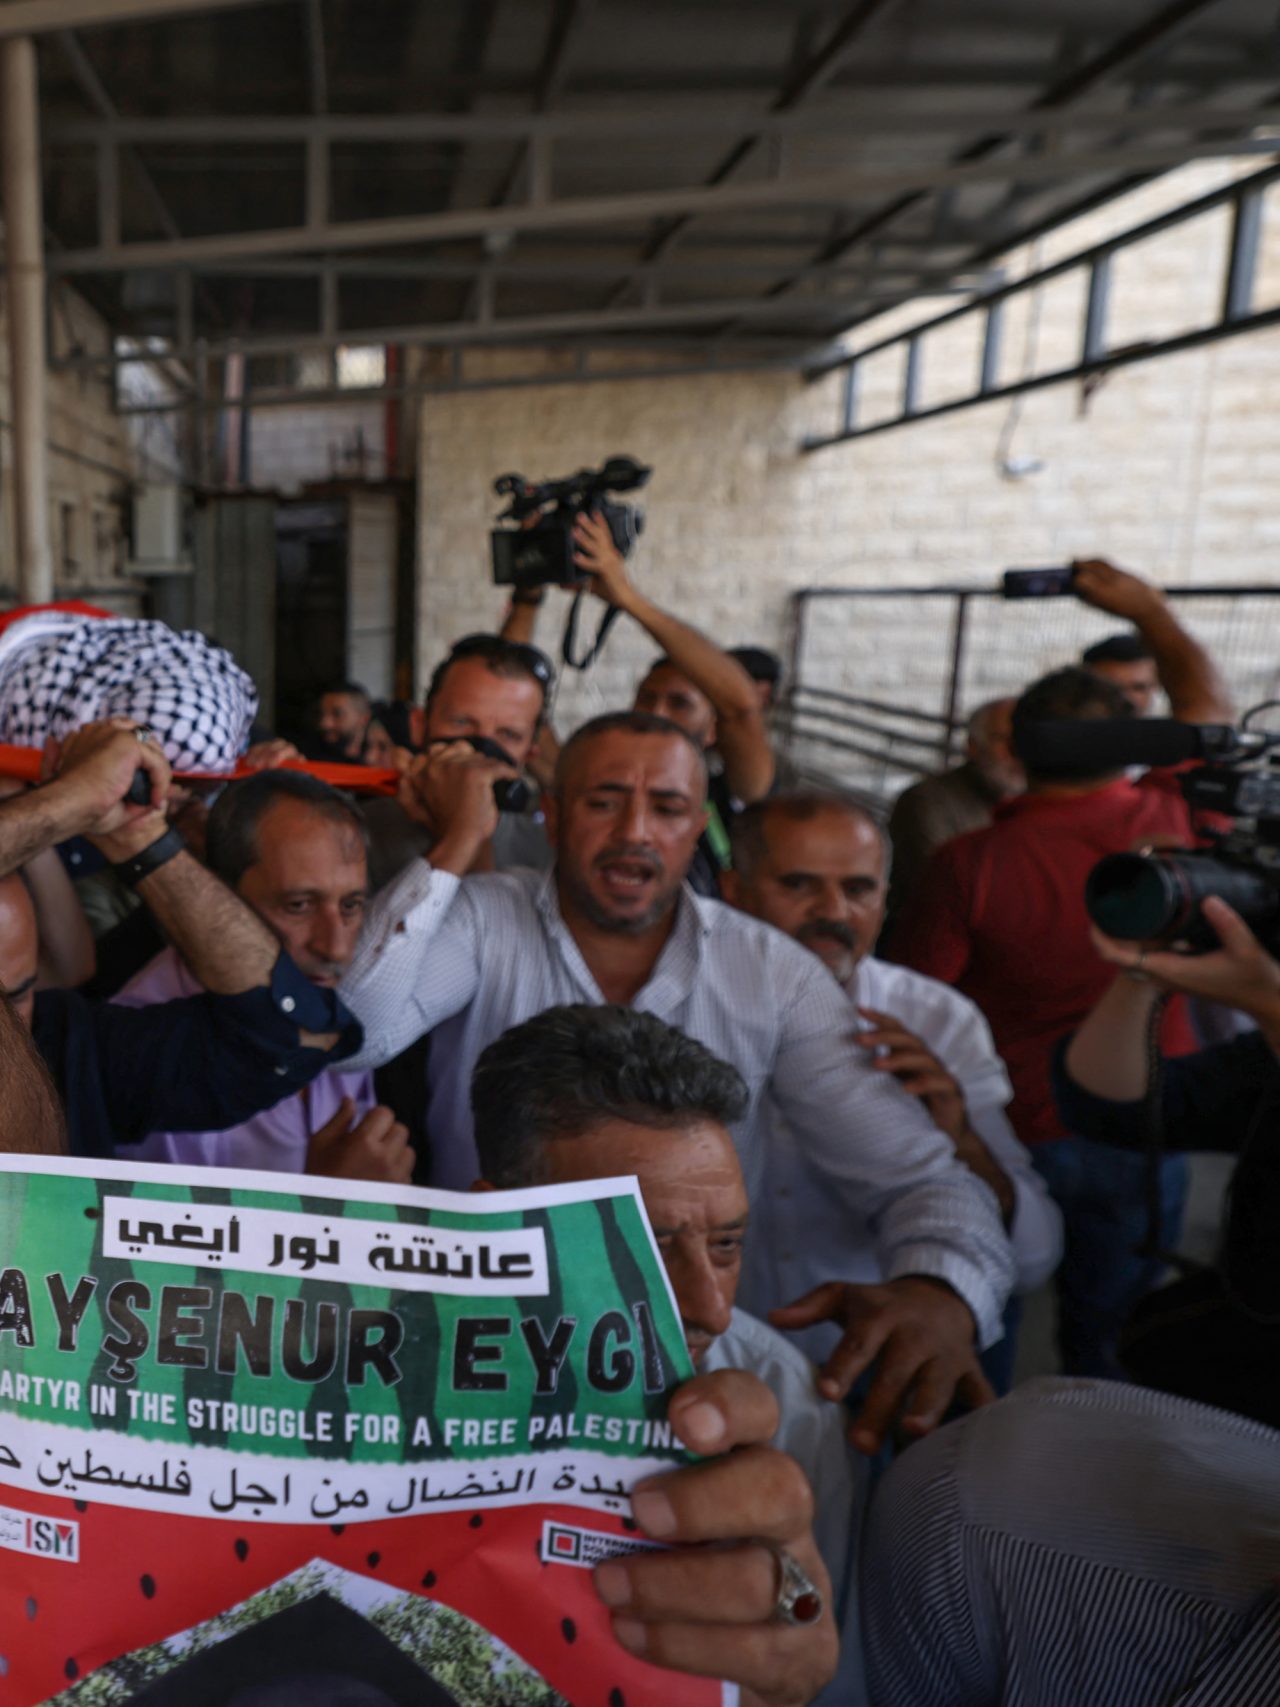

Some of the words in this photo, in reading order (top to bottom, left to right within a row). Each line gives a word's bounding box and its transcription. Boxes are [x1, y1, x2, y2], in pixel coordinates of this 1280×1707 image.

[268, 1227, 340, 1271] نور
[368, 1232, 535, 1278] عائشة
[452, 1301, 666, 1395] EYGI
[90, 1385, 116, 1417] IN
[127, 1390, 176, 1425] THE
[187, 1398, 334, 1442] STRUGGLE
[344, 1413, 400, 1444] FOR
[412, 1416, 433, 1447] A
[444, 1417, 518, 1447] FREE
[37, 1448, 191, 1496] فلسطين
[210, 1468, 291, 1516] اجل
[387, 1467, 536, 1514] النضال
[311, 1477, 370, 1518] من
[26, 1518, 74, 1557] ISM
